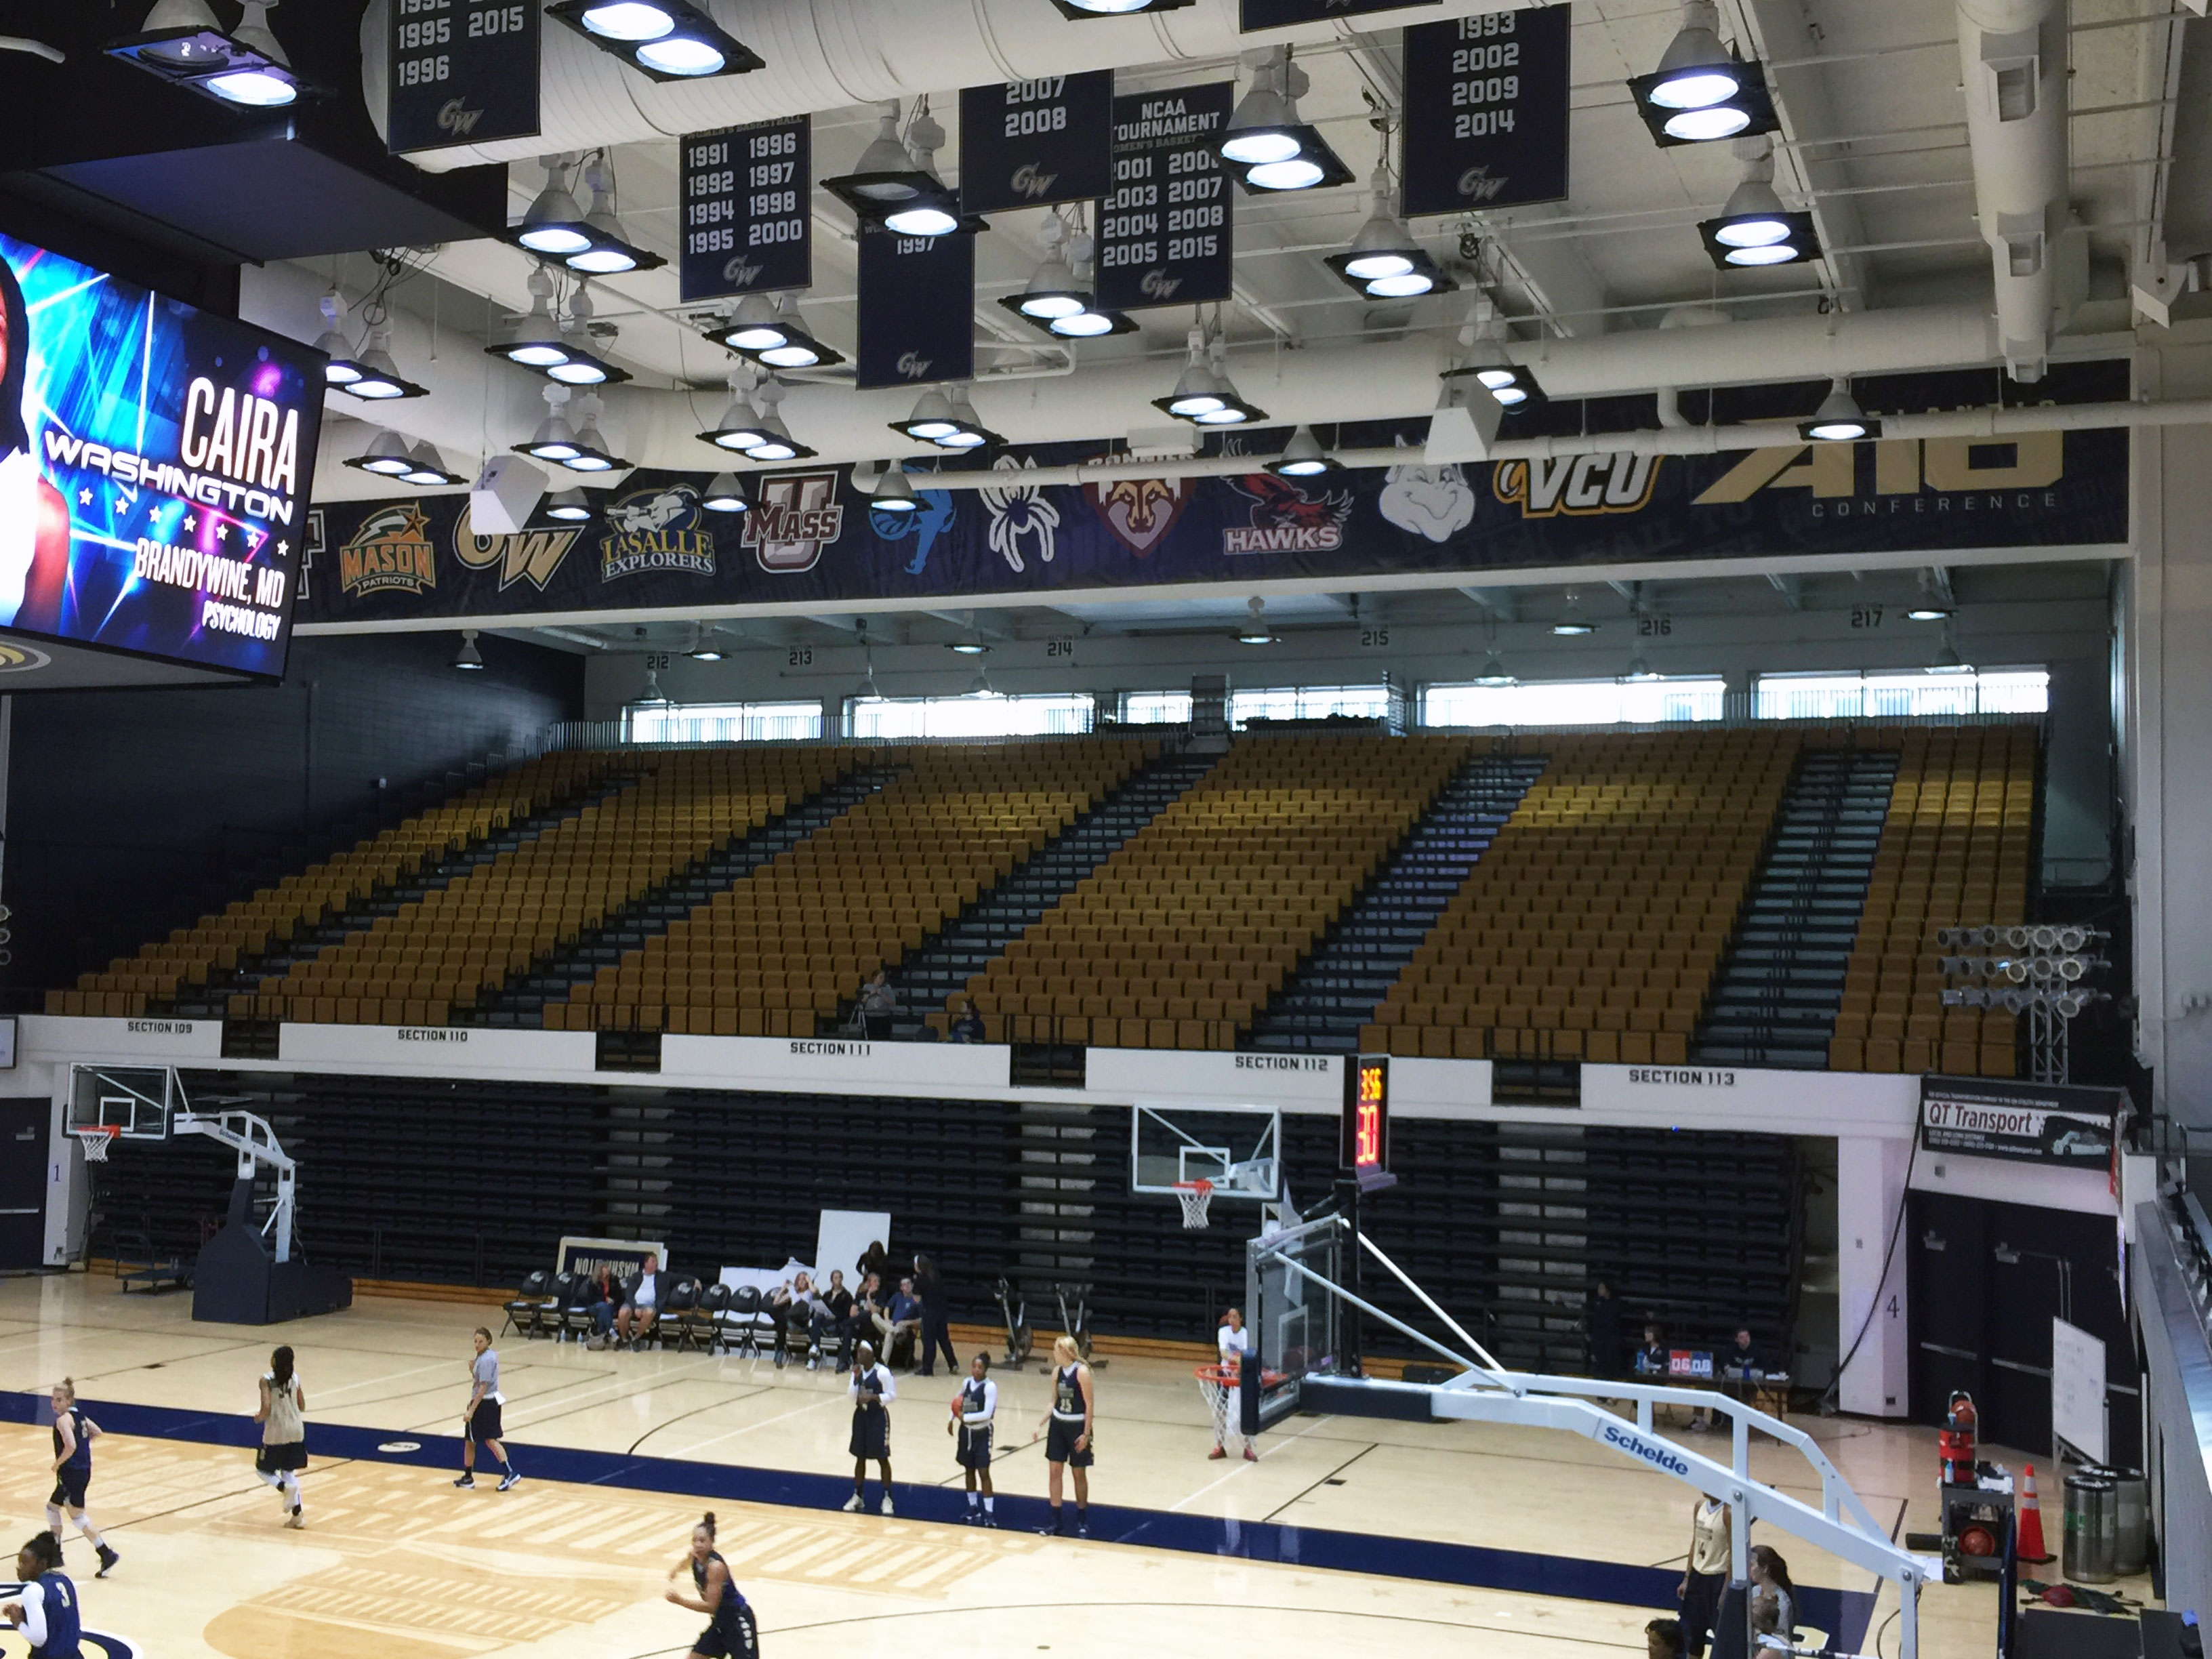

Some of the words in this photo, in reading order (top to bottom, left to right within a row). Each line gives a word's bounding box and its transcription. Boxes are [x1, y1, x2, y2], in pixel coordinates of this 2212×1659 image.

[398, 18, 451, 49] 1995
[468, 6, 524, 37] 2015
[1458, 10, 1515, 40] 1993
[398, 55, 449, 86] 1996
[1453, 43, 1519, 73] 2002
[1006, 75, 1065, 104] 2007
[1452, 75, 1519, 106] 2009
[1006, 106, 1067, 138] 2008
[1142, 99, 1185, 120] NCAA
[1114, 112, 1219, 141] OURNAMENT
[1455, 109, 1515, 138] 2014
[689, 142, 728, 168] 1991
[750, 132, 796, 159] 1996
[750, 161, 795, 188] 1997
[1114, 157, 1151, 181] 001
[689, 171, 734, 197] 1992
[1168, 177, 1222, 203] 2007
[689, 199, 735, 226] 1994
[750, 190, 796, 217] 1998
[1103, 213, 1158, 239] 2004
[1168, 205, 1223, 232] 2008
[689, 228, 733, 254] 1995
[749, 219, 802, 246] 2000
[897, 237, 935, 255] 1997
[1103, 241, 1158, 267] 2005
[1168, 234, 1217, 260] 2015
[181, 377, 298, 495] CAIRA
[44, 430, 293, 526] WASHINGTON
[1525, 451, 1660, 514] VCU
[1811, 492, 2056, 518] CONFERENCE
[1225, 525, 1340, 554] HAWKS
[136, 537, 251, 602] BRANDYWINE,
[256, 567, 284, 608] MD
[342, 544, 432, 584] MASON
[605, 552, 713, 577] EXPLORERS
[362, 575, 415, 588] PATRIOTS
[202, 600, 280, 641] PSYCHOLOGY
[1641, 619, 1672, 636] 216
[1851, 610, 1883, 628] 217
[1047, 642, 1072, 657] 214
[1361, 630, 1389, 646] 215
[647, 655, 669, 670] 212
[789, 651, 812, 665] 213
[127, 1021, 171, 1031] SECTION
[175, 1023, 192, 1033] 109
[398, 1029, 446, 1040] SECTION
[450, 1030, 468, 1042] 110
[790, 1042, 844, 1054] SECTION
[850, 1044, 870, 1055] 111
[1235, 1055, 1298, 1070] SECTION
[1305, 1059, 1328, 1071] 112
[1629, 1069, 1702, 1084] SECTION
[1708, 1073, 1734, 1086] 113
[1929, 1103, 1950, 1124] QT
[1955, 1105, 2032, 1134] Transport
[54, 1165, 60, 1182] 1
[1887, 1294, 1900, 1318] 4
[1605, 1426, 1688, 1476] Schelde
[56, 1582, 70, 1607] 3
